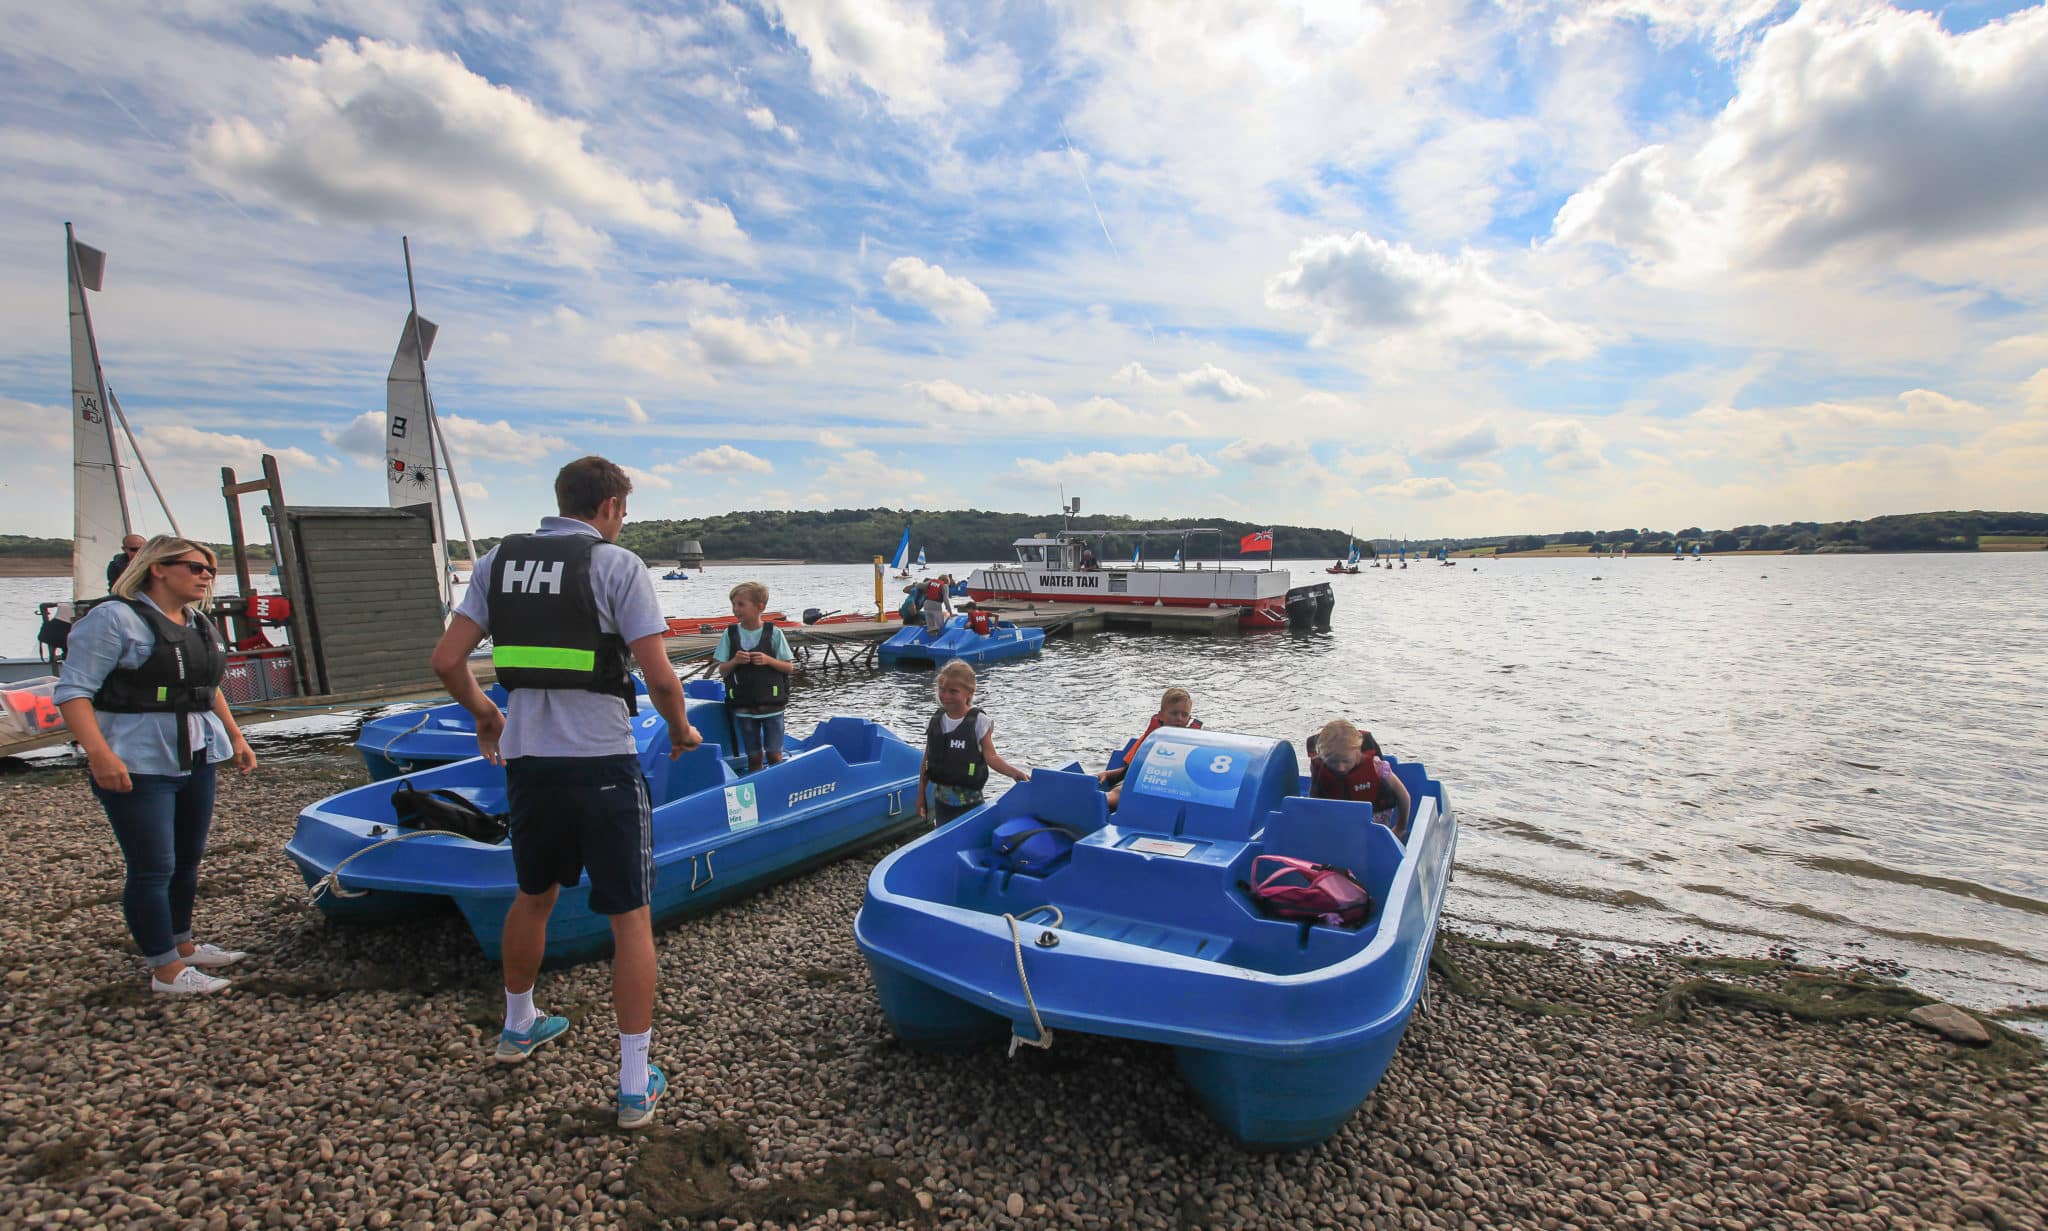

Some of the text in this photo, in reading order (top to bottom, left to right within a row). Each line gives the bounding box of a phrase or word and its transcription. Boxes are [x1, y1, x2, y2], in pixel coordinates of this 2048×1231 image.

[502, 560, 564, 594] HH
[1040, 575, 1099, 588] WATER TAXI
[950, 740, 966, 749] HH
[1145, 765, 1174, 778] Boat
[1209, 755, 1232, 774] 8
[1142, 774, 1168, 786] Hire
[743, 787, 751, 802] 6
[788, 782, 837, 808] pioner
